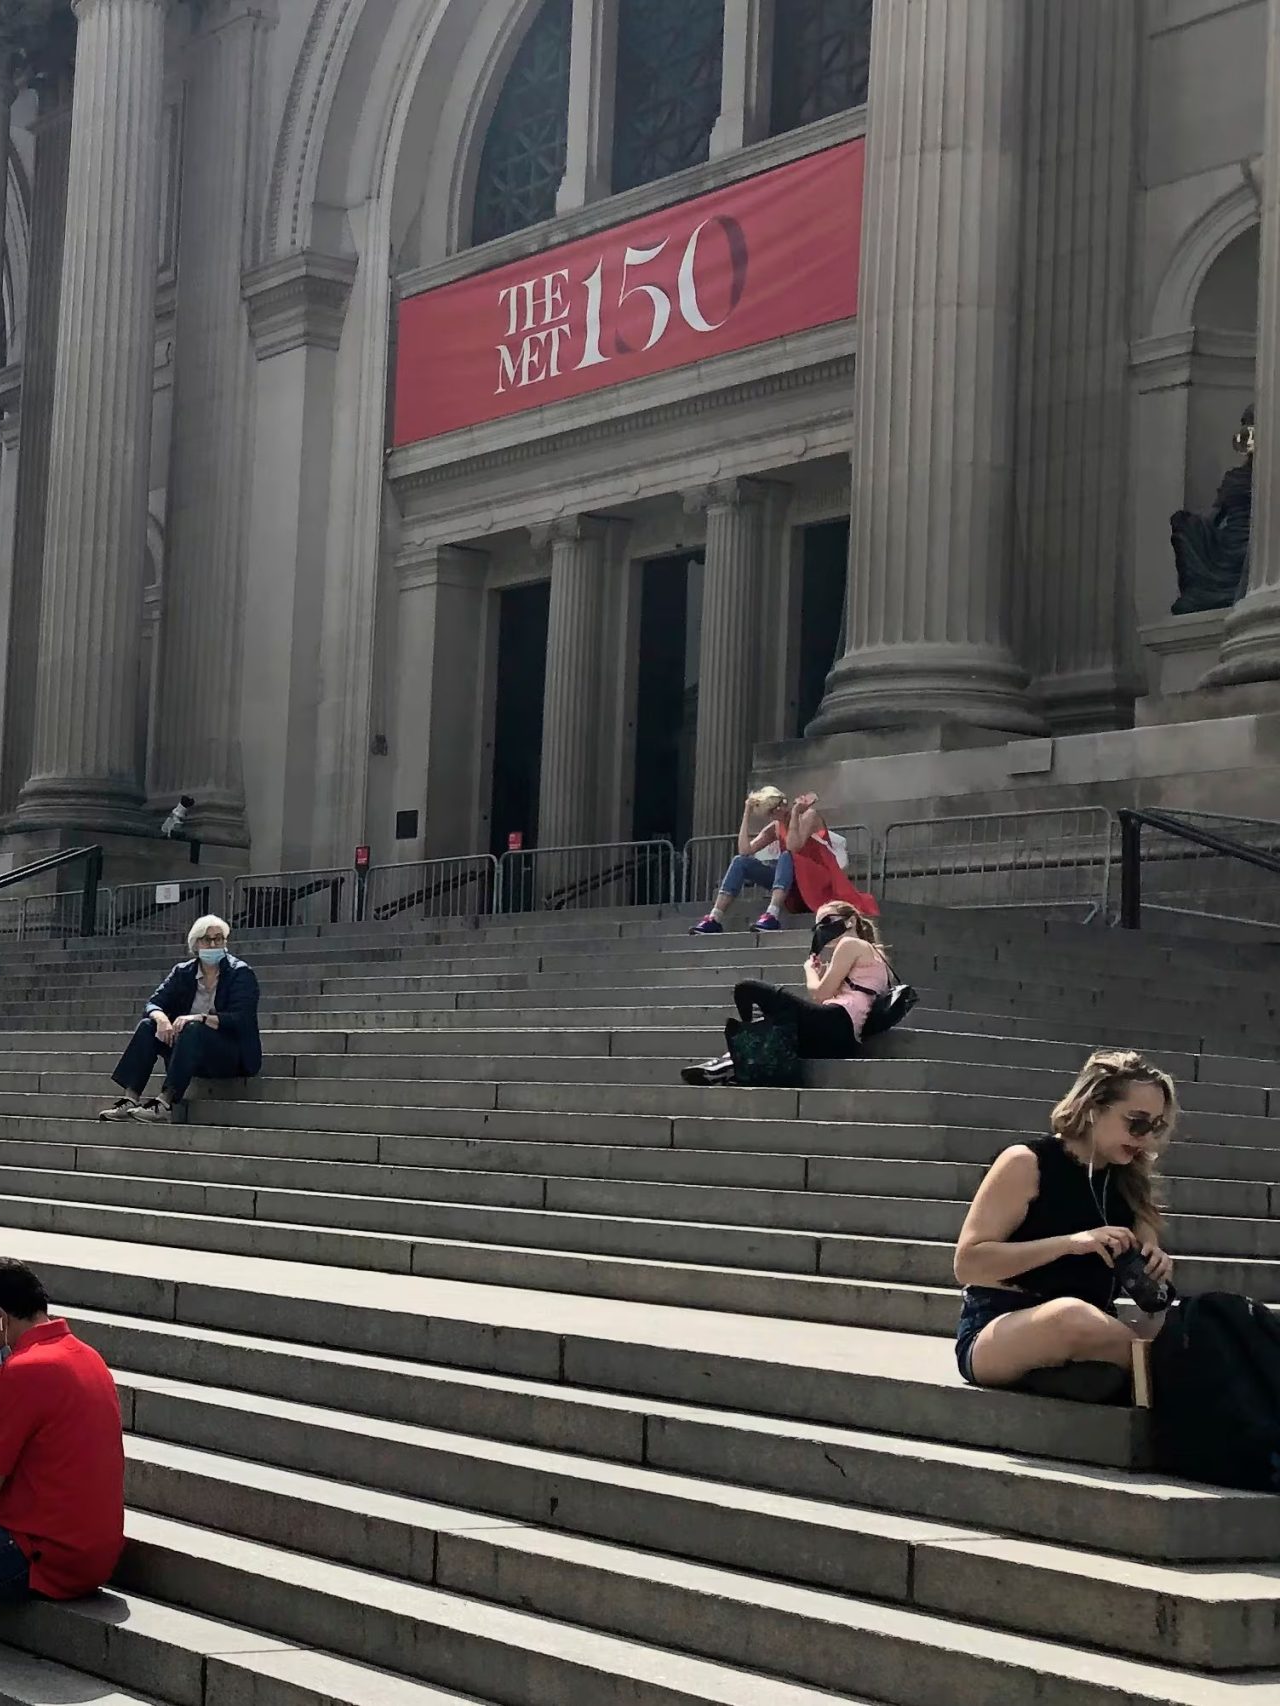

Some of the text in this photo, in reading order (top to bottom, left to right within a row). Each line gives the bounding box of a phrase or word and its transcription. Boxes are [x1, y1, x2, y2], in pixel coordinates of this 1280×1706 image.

[498, 268, 570, 337] THE
[572, 215, 748, 371] 150
[494, 323, 571, 395] MET
